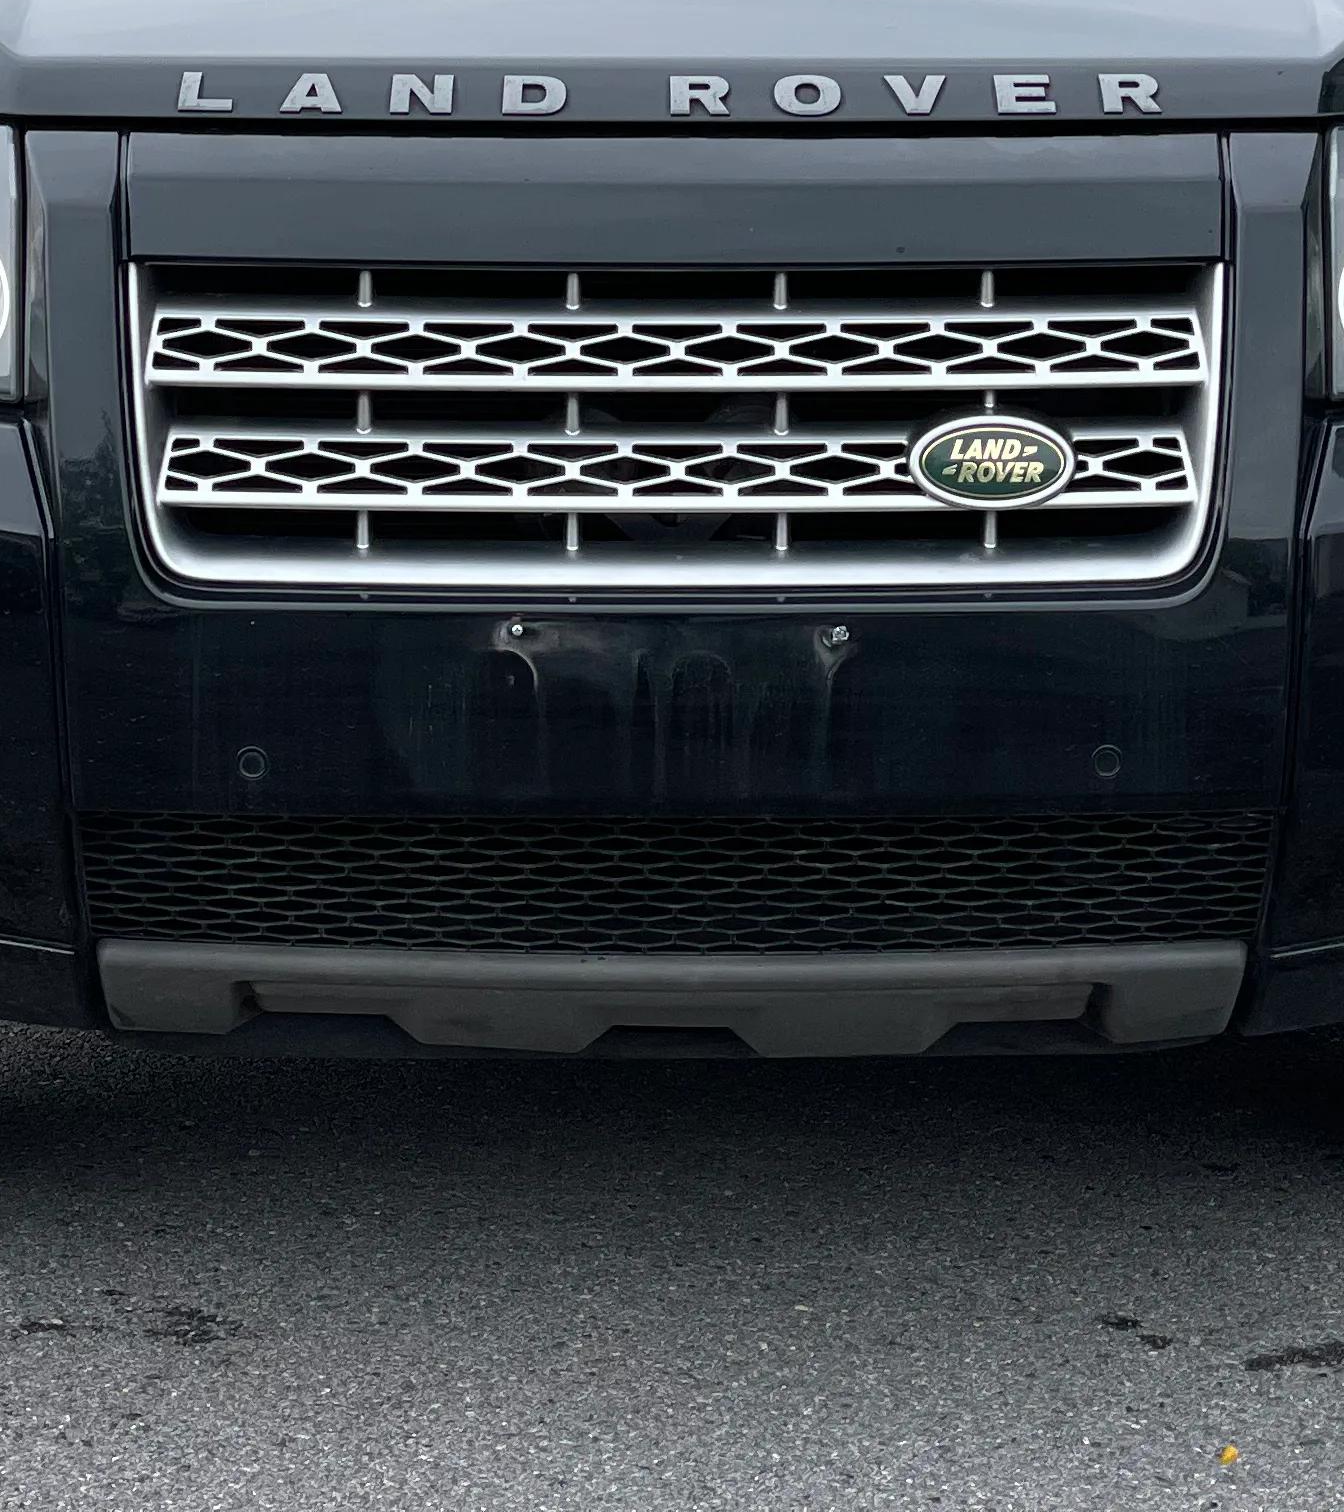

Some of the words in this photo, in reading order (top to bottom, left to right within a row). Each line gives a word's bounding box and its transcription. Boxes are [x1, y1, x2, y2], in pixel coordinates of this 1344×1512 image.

[177, 71, 567, 115] LAND
[669, 73, 1162, 116] ROVER
[950, 438, 1022, 460] LAND
[957, 461, 1045, 483] ROVER
